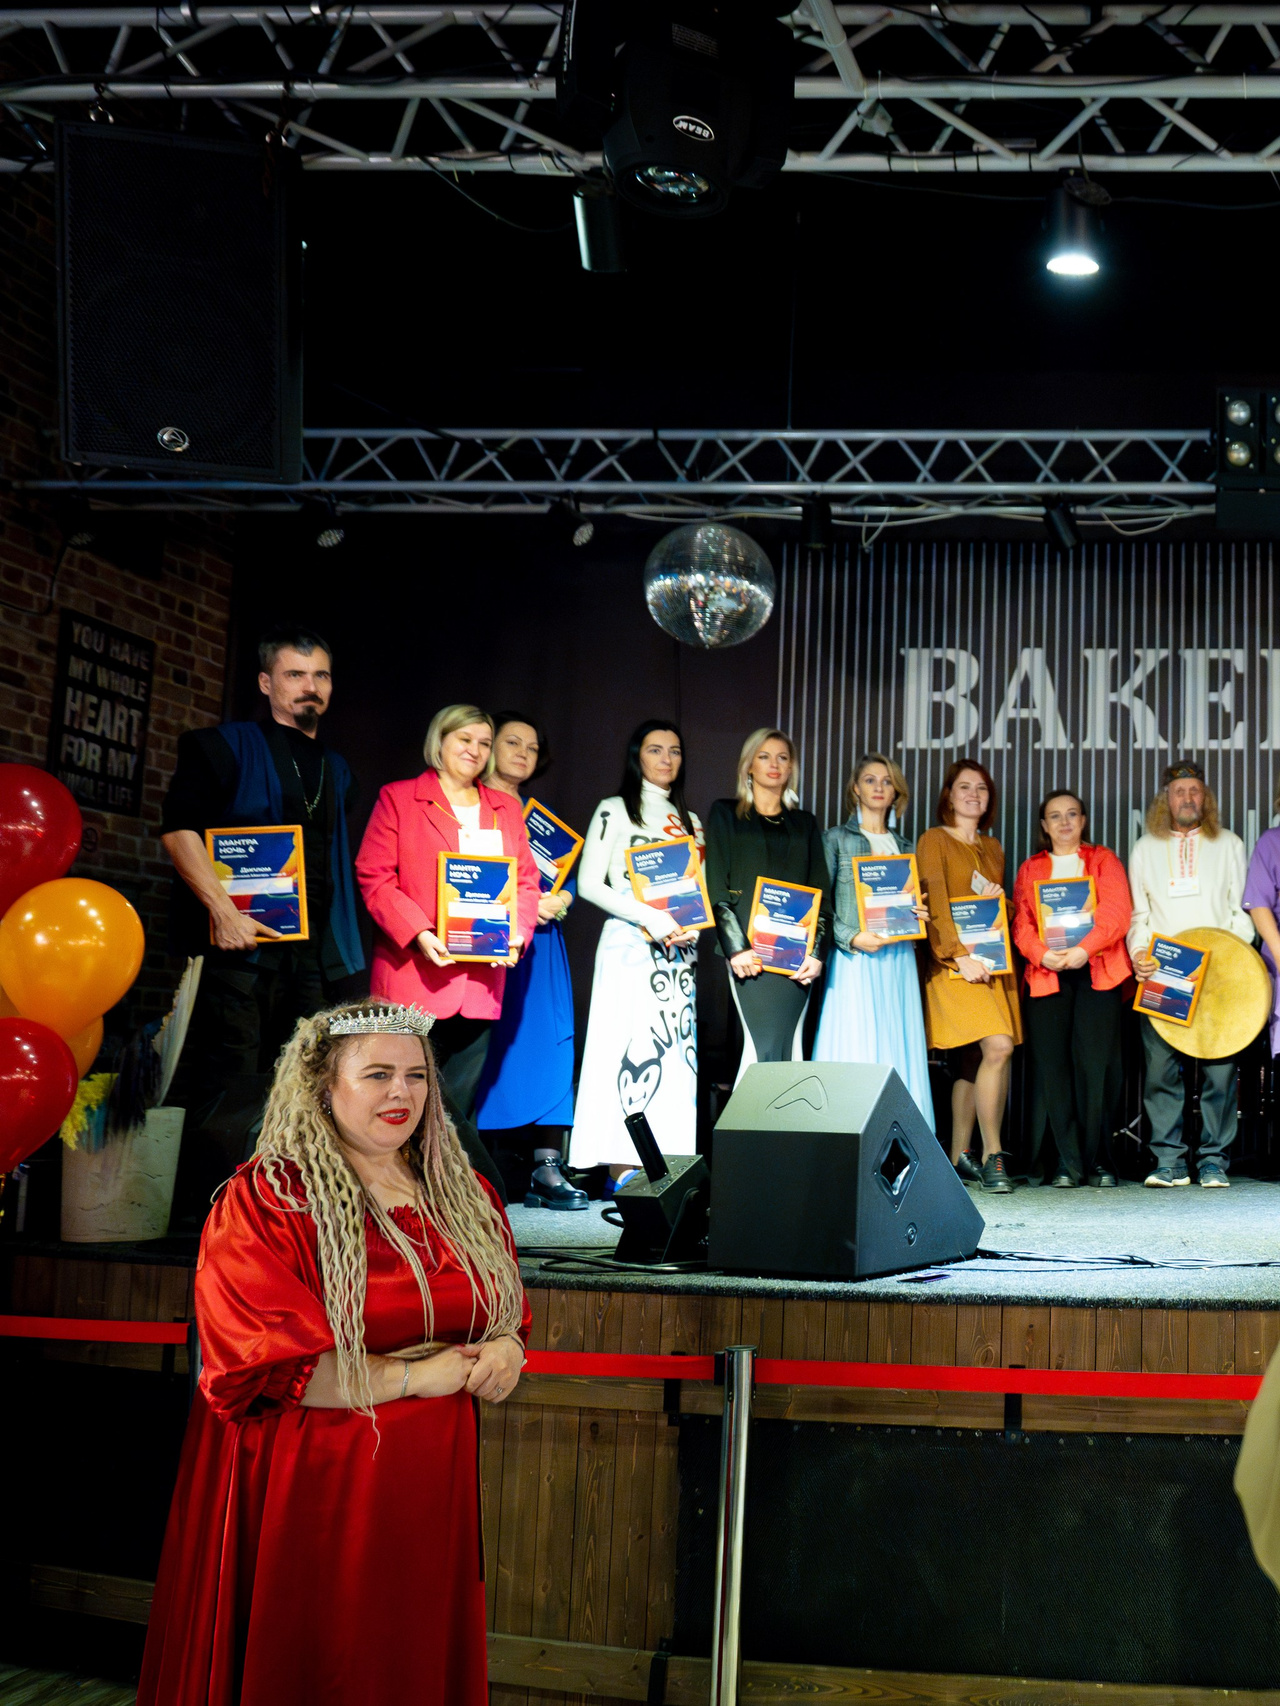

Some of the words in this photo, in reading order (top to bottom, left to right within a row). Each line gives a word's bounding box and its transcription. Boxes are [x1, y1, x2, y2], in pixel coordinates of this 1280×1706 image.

[676, 120, 710, 138] BEAM
[71, 620, 105, 653] YOU
[68, 654, 96, 683] MY
[96, 664, 148, 702] WHOLE
[63, 686, 143, 748] HEART
[60, 733, 102, 774] FOR
[107, 748, 138, 782] MY
